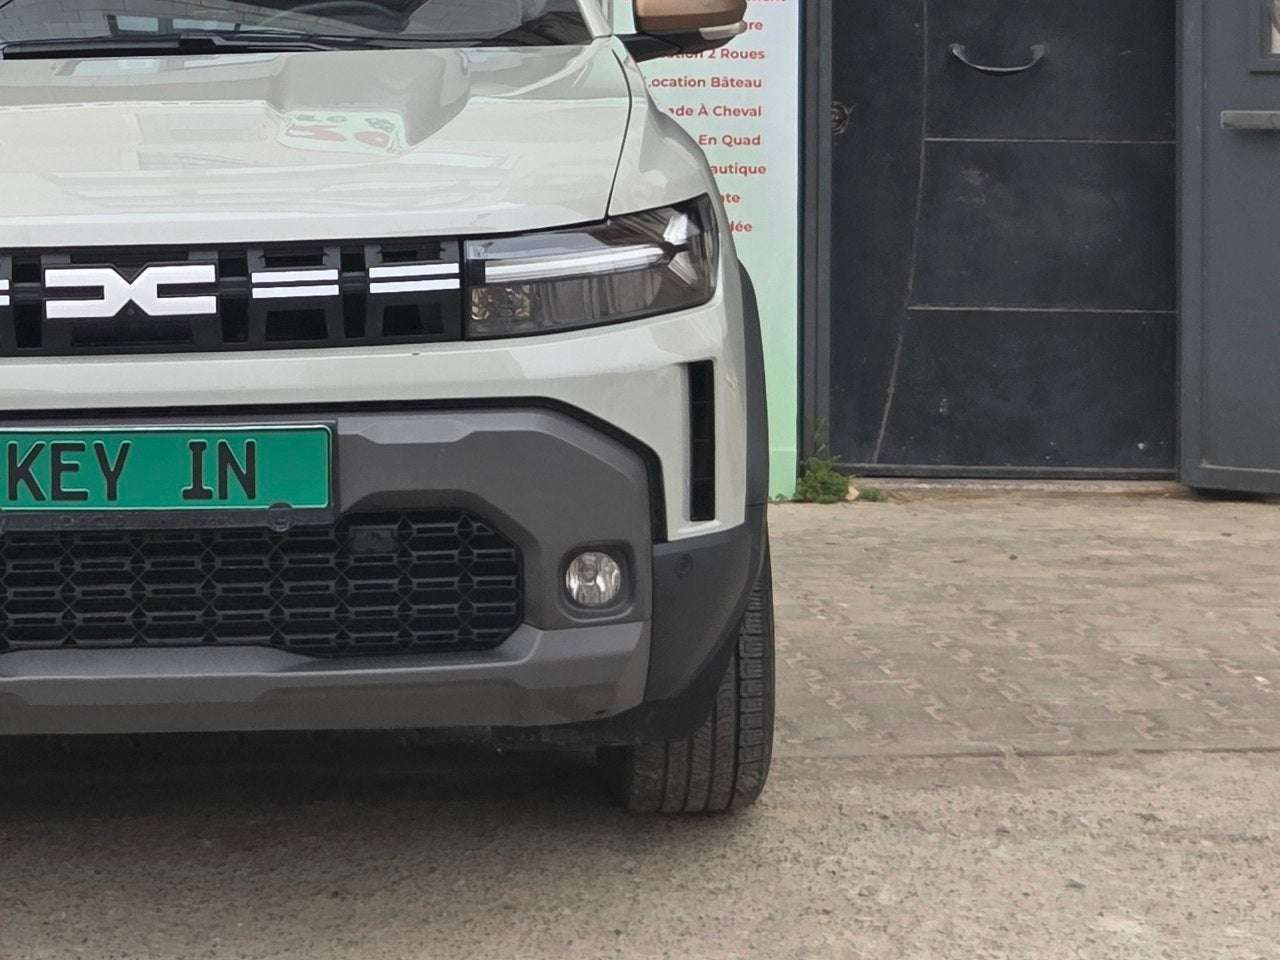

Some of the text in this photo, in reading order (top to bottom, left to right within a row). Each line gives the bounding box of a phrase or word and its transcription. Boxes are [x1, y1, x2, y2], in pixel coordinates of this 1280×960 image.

[720, 48, 765, 59] Roues
[648, 76, 762, 88] ocation Bâteau
[712, 105, 762, 116] Cheval
[698, 134, 761, 147] En Quad
[6, 439, 257, 502] KEY IN
